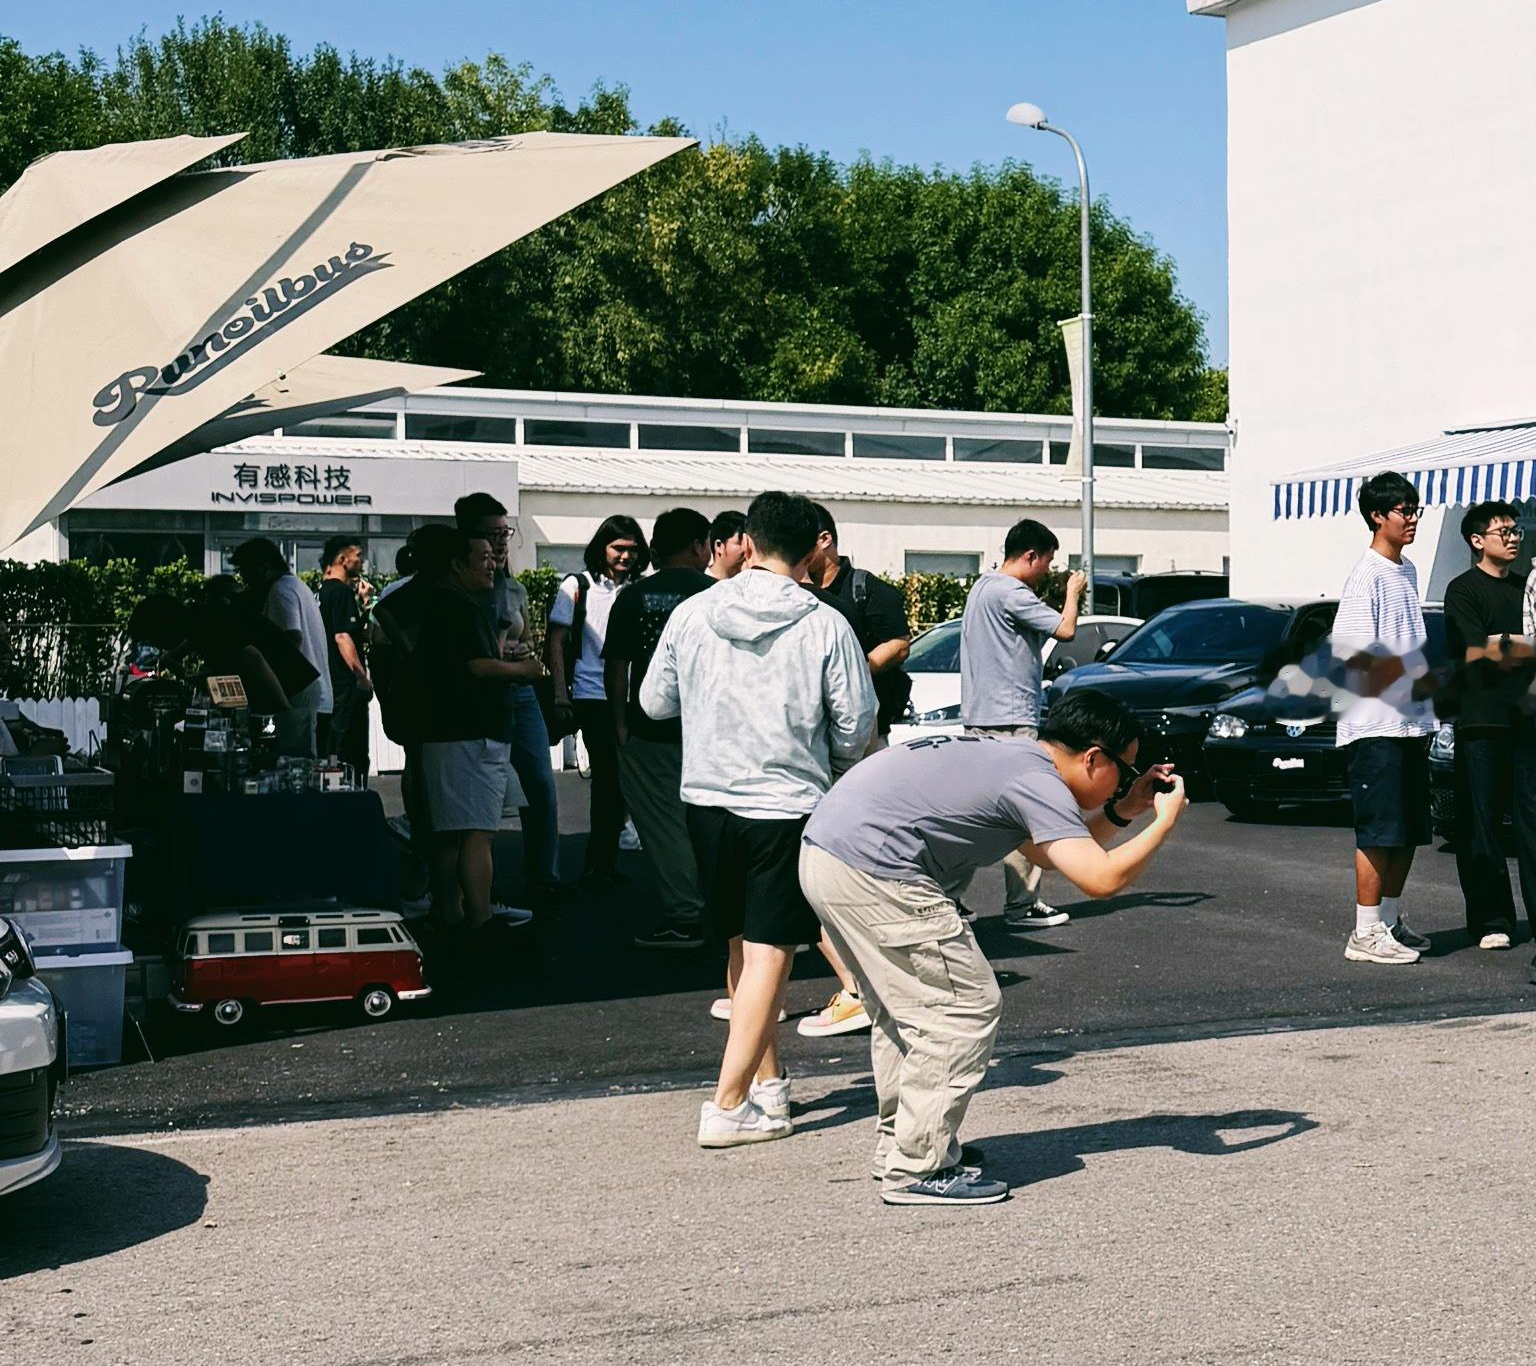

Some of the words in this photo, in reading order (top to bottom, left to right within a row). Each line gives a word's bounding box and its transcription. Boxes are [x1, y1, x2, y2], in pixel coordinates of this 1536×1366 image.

[93, 242, 374, 427] Runoilbus
[233, 462, 352, 492] 有感科技
[211, 491, 373, 506] INVISPOWER
